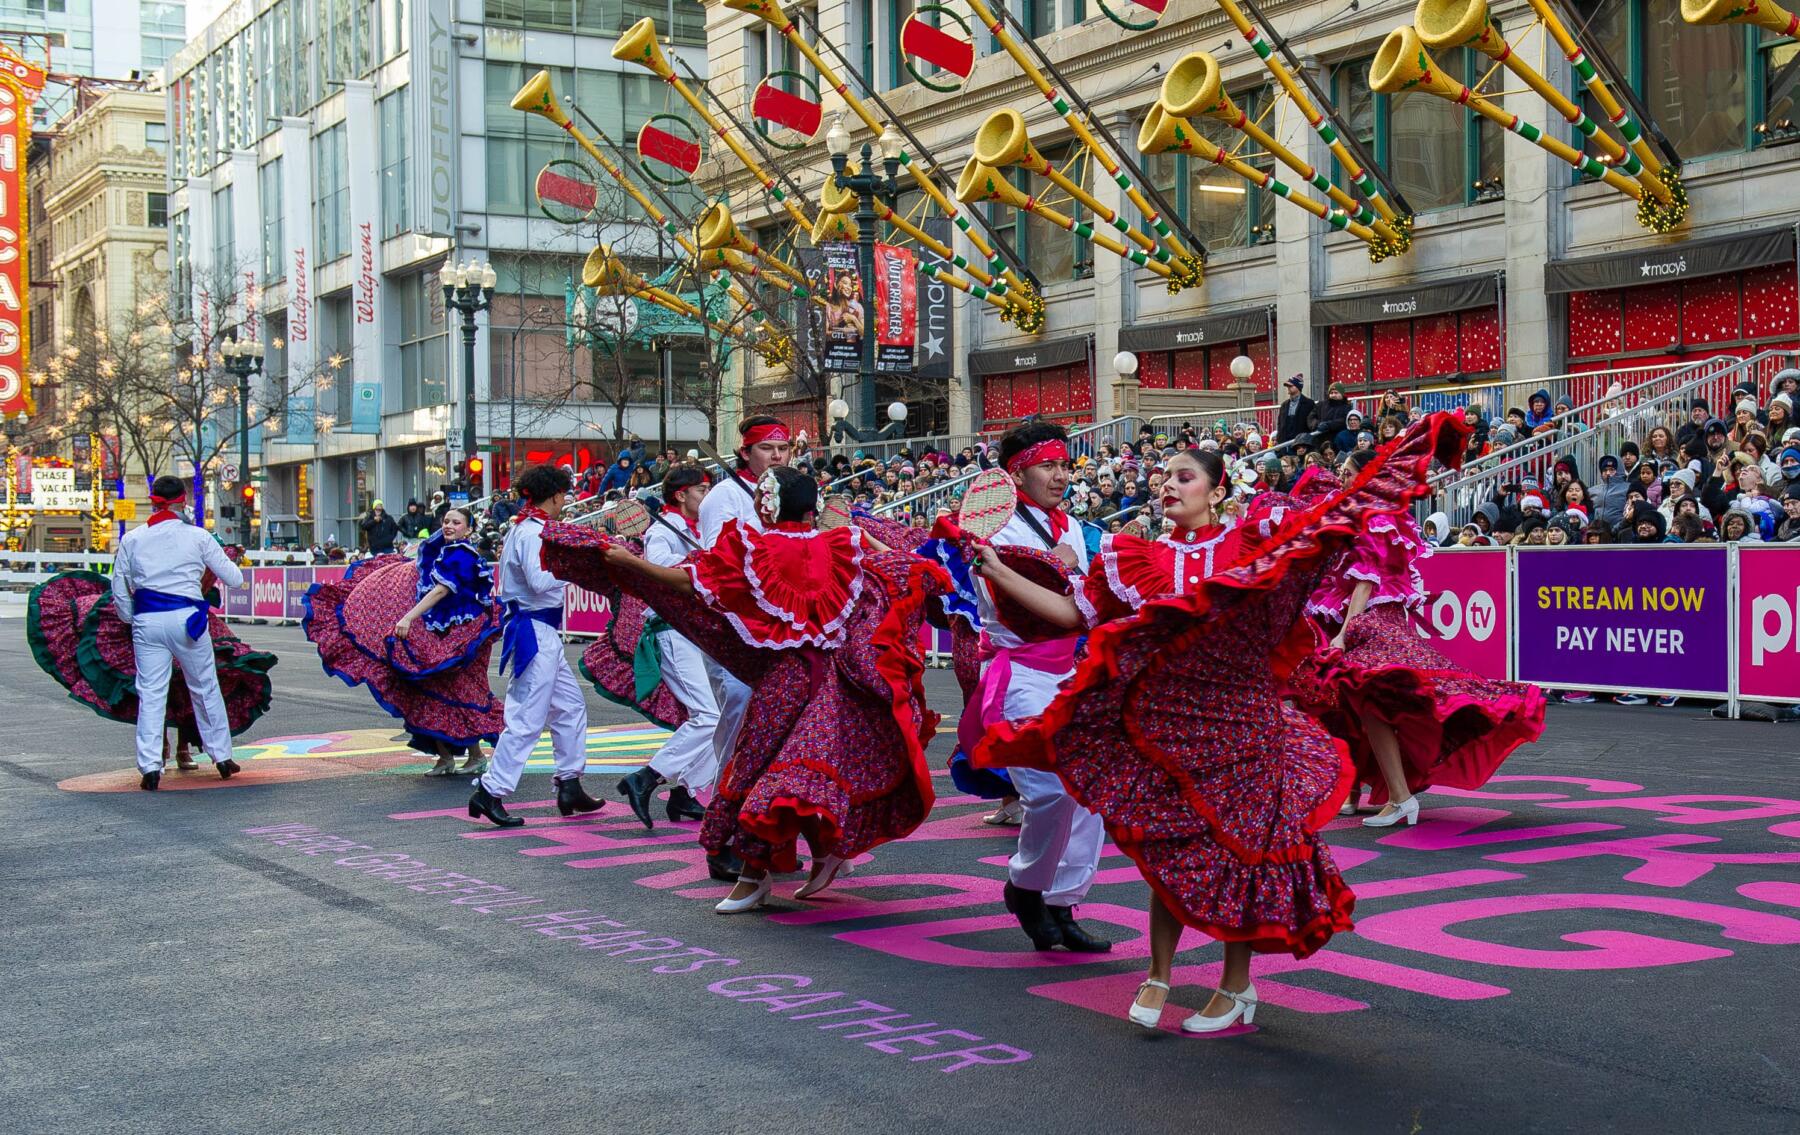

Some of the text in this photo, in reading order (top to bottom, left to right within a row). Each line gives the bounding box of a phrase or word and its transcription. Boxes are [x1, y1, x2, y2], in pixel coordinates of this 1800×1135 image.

[430, 11, 450, 231] JOFFREY
[357, 221, 379, 324] Walgreens
[1651, 256, 1687, 276] macy's
[291, 247, 312, 343] Walgreens
[886, 253, 905, 338] NUTCRACKER
[35, 471, 67, 480] CHASE
[46, 497, 58, 505] 26
[1538, 586, 1705, 612] STREAM NOW
[1556, 626, 1685, 655] PAY NEVER
[240, 822, 1033, 1073] WHERE GRATEFUL HEARTS GATHER
